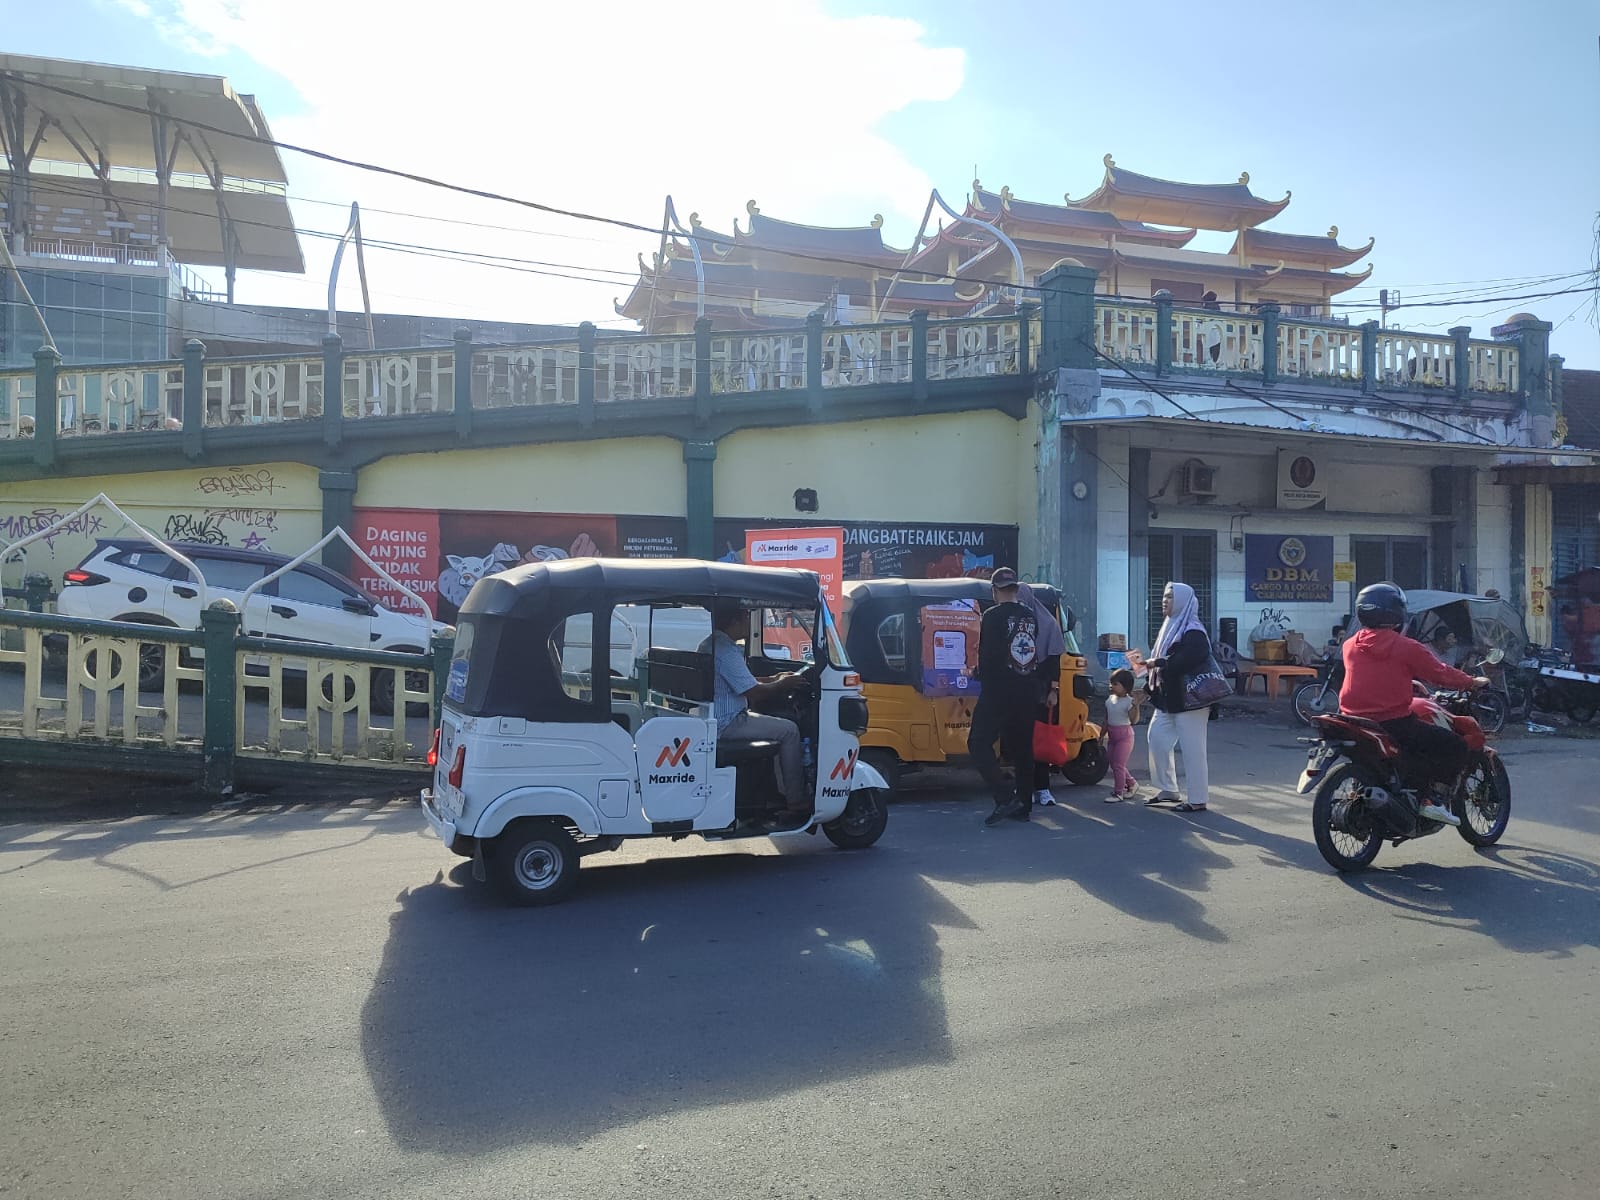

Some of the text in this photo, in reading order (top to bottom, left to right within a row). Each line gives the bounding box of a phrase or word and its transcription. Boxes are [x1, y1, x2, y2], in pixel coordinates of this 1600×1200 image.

[366, 526, 428, 542] DAGING
[369, 545, 427, 560] ANJING
[768, 544, 798, 552] Maxride
[1266, 567, 1320, 582] DBM
[374, 595, 426, 609] ALAM
[648, 773, 696, 784] Maxride
